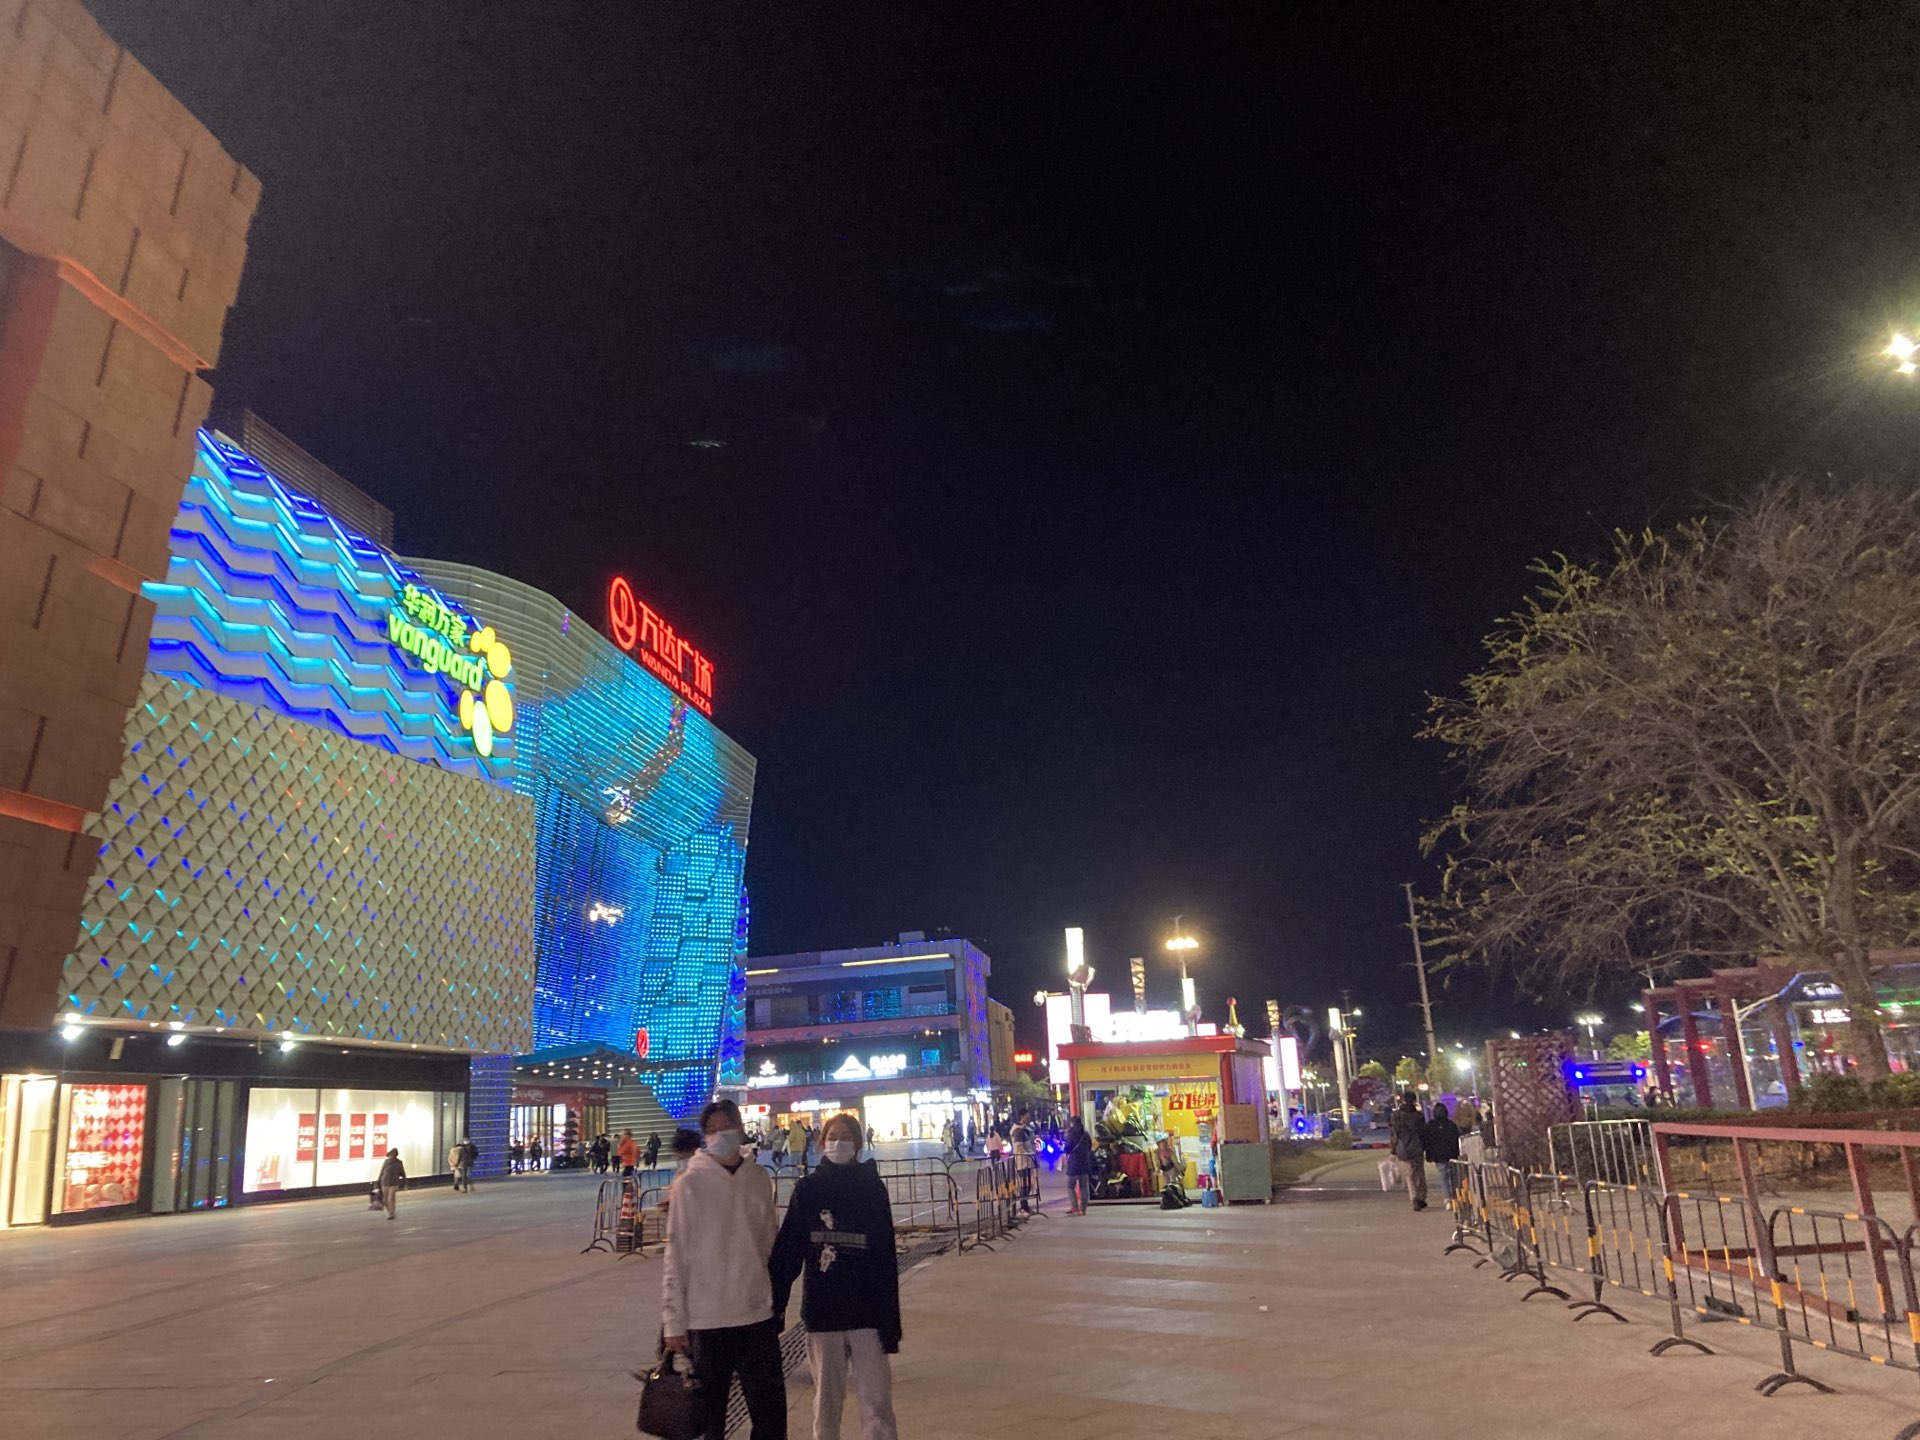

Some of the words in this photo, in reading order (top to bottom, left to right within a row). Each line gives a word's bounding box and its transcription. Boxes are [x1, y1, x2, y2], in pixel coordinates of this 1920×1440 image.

[389, 613, 483, 691] vanguard
[403, 583, 468, 648] 华润万家
[639, 600, 712, 698] 万达广场
[640, 647, 680, 690] WANDA
[681, 680, 712, 716] PLAZA
